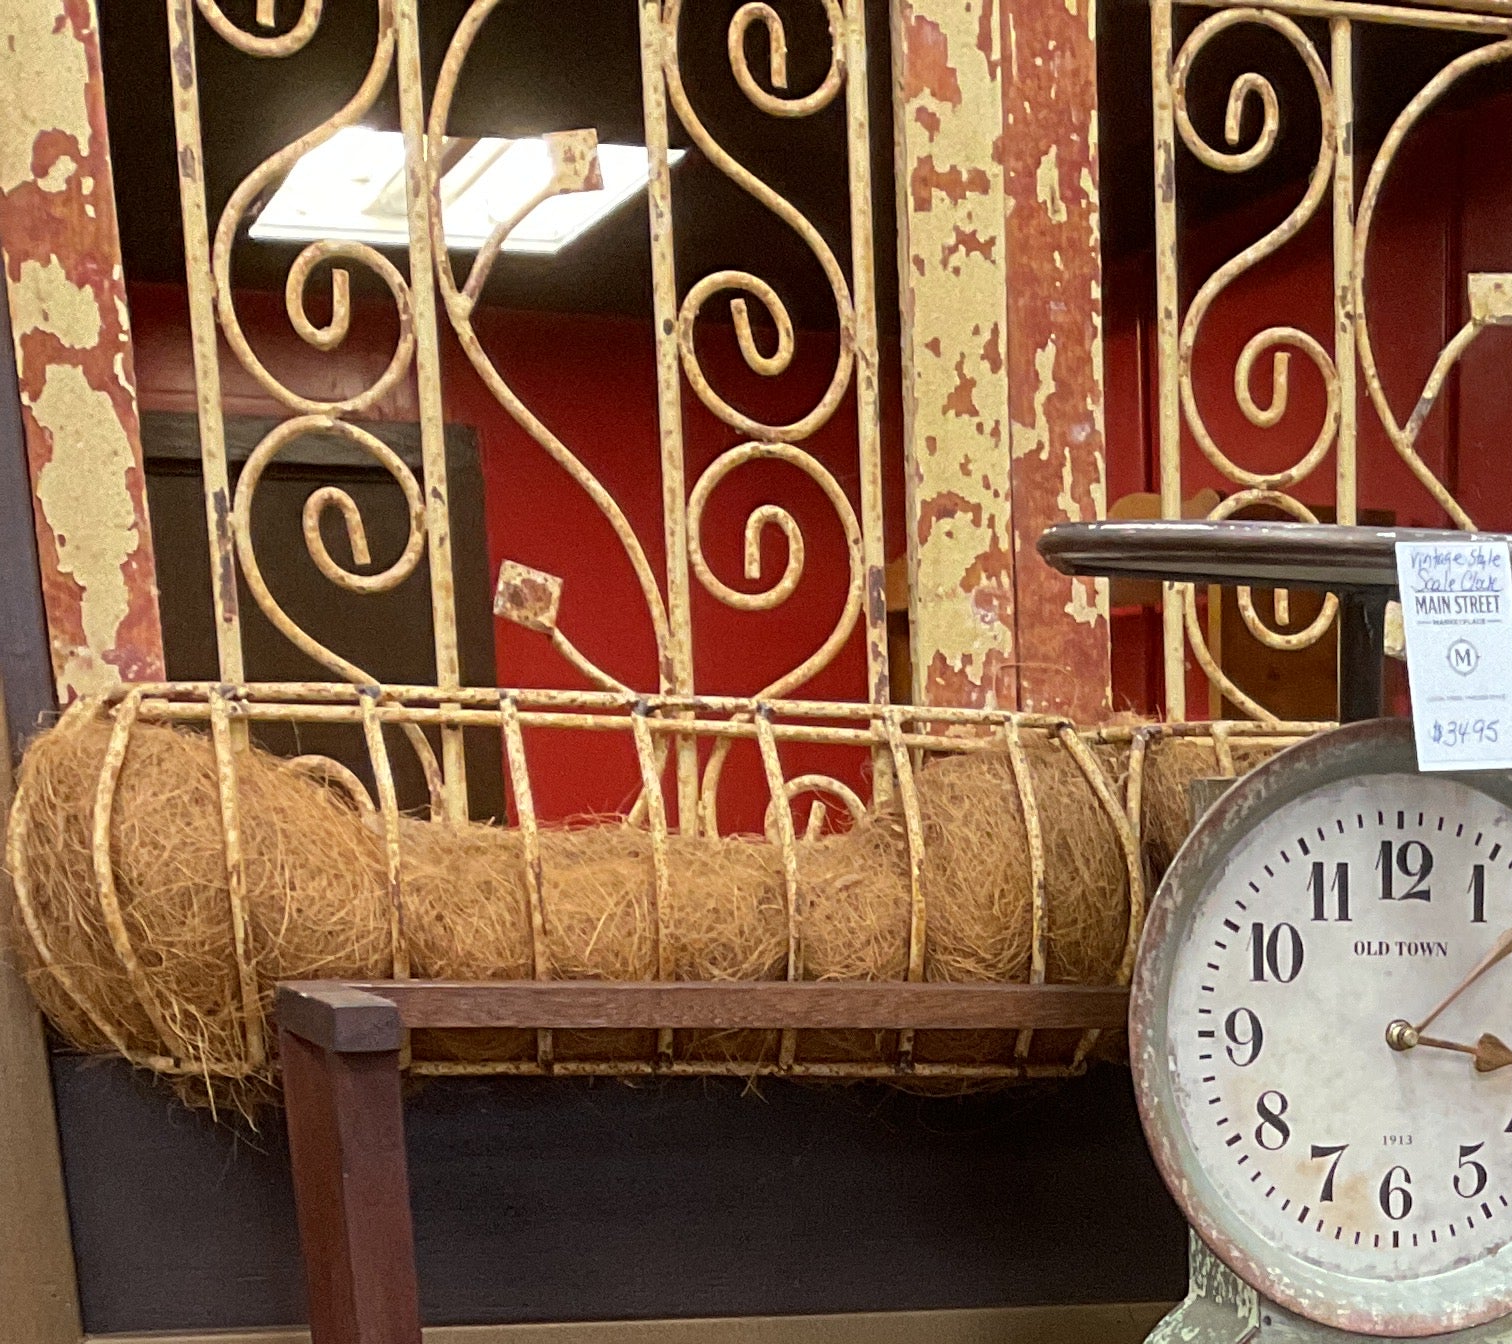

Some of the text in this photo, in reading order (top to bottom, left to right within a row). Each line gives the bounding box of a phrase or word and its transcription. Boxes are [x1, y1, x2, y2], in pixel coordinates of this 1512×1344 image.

[1416, 567, 1456, 592] Scale
[1468, 547, 1501, 569] Style
[1415, 594, 1500, 615] MAIN STREET
[1454, 648, 1472, 668] M
[1306, 861, 1353, 922] 11
[1375, 839, 1434, 902] 12
[1467, 863, 1488, 923] 1
[1247, 921, 1304, 984] 10
[1353, 940, 1449, 957] OLD TOWN
[1224, 1007, 1264, 1067] 9
[1254, 1090, 1291, 1151] 8
[1381, 1134, 1413, 1146] 1913
[1310, 1143, 1350, 1203] 7
[1379, 1165, 1413, 1221] 6
[1452, 1141, 1488, 1199] 5
